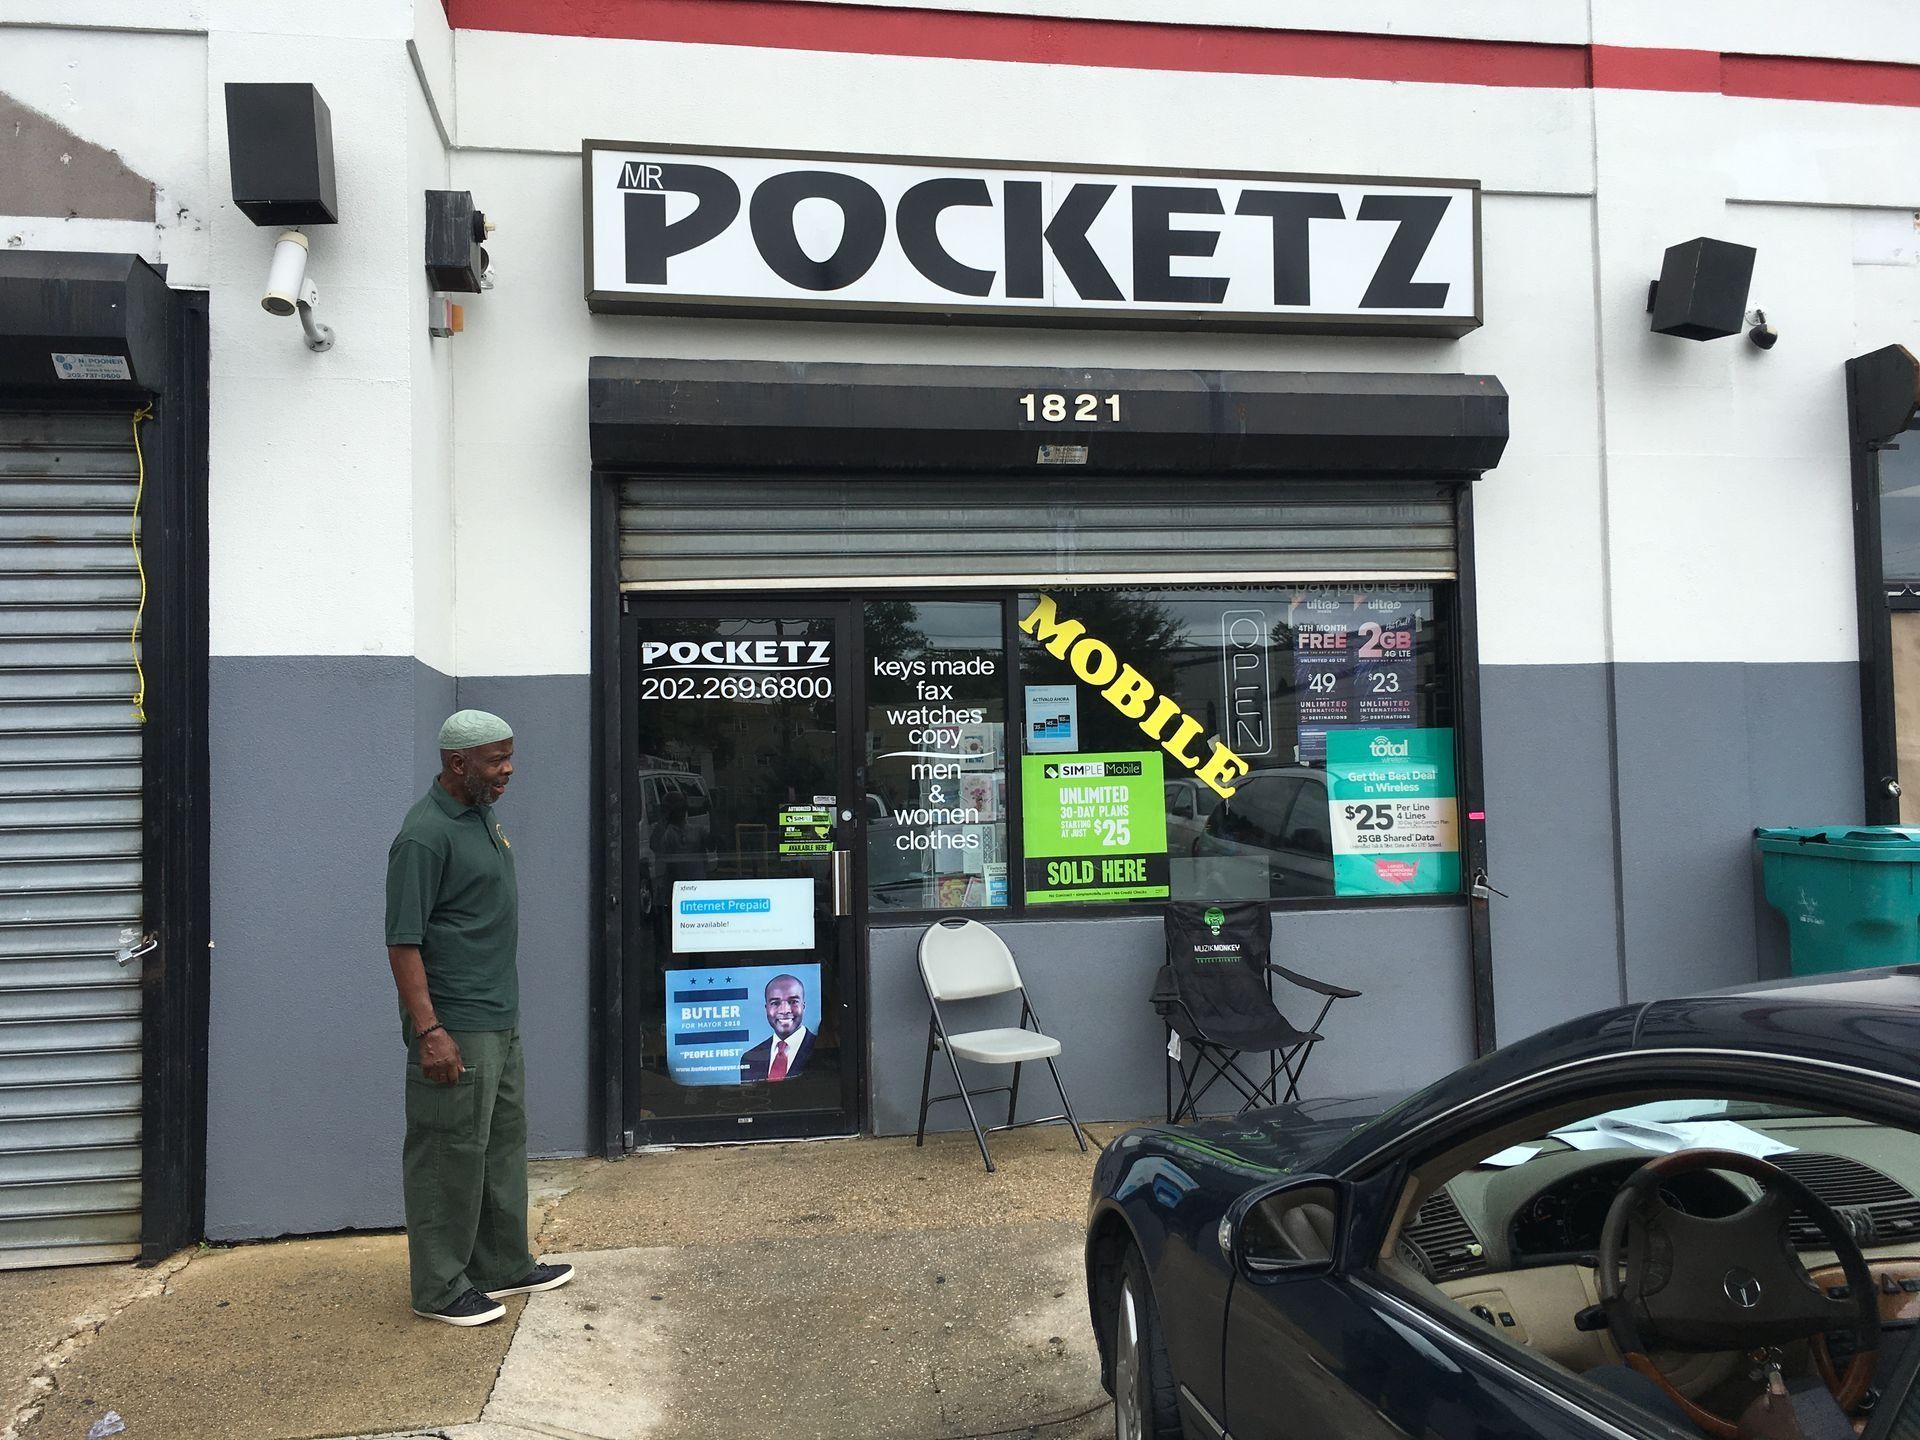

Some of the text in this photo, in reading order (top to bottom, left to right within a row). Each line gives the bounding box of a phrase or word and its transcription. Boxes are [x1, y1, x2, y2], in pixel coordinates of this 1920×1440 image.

[624, 163, 664, 189] MR
[616, 161, 1453, 309] POCKETZ
[1019, 393, 1121, 422] 1821
[1316, 624, 1347, 632] MONTH
[1298, 633, 1347, 649] FREE
[1358, 621, 1412, 658] 2GB
[641, 641, 831, 665] POCKETZ
[1384, 650, 1397, 658] 4G
[873, 656, 995, 681] keys made
[641, 677, 832, 700] 202.269.6800
[916, 680, 954, 701] fax
[1229, 618, 1264, 747] OPEN
[1308, 673, 1336, 693] $49
[1368, 673, 1399, 693] $23
[1018, 593, 1249, 799] MOBILE
[886, 705, 984, 725] watches
[908, 728, 963, 749] copy
[1369, 739, 1409, 757] total
[911, 763, 962, 780] men
[1062, 763, 1140, 776] SIMPLE Mobile
[1348, 770, 1436, 782] Get the Best Deal
[928, 784, 946, 804] &
[1059, 785, 1129, 805] UNLIMITED
[1364, 782, 1420, 793] in Wireless
[894, 807, 980, 826] women
[1060, 804, 1129, 819] 30-DAY PLANS
[1396, 803, 1430, 811] Per Line
[1404, 812, 1426, 820] Lines
[1060, 819, 1091, 829] STARTING
[1345, 804, 1394, 831] $25
[896, 830, 980, 850] clothes
[1061, 828, 1087, 838] AT JUST
[1093, 818, 1131, 846] $25
[1357, 834, 1382, 843] 25GB
[1415, 833, 1435, 841] Data
[1047, 858, 1148, 886] SOLD HERE
[682, 899, 770, 912] Internet Prepaid
[681, 1005, 741, 1020] BUTLER
[681, 1022, 696, 1030] FOR
[697, 1021, 722, 1029] MAYOR
